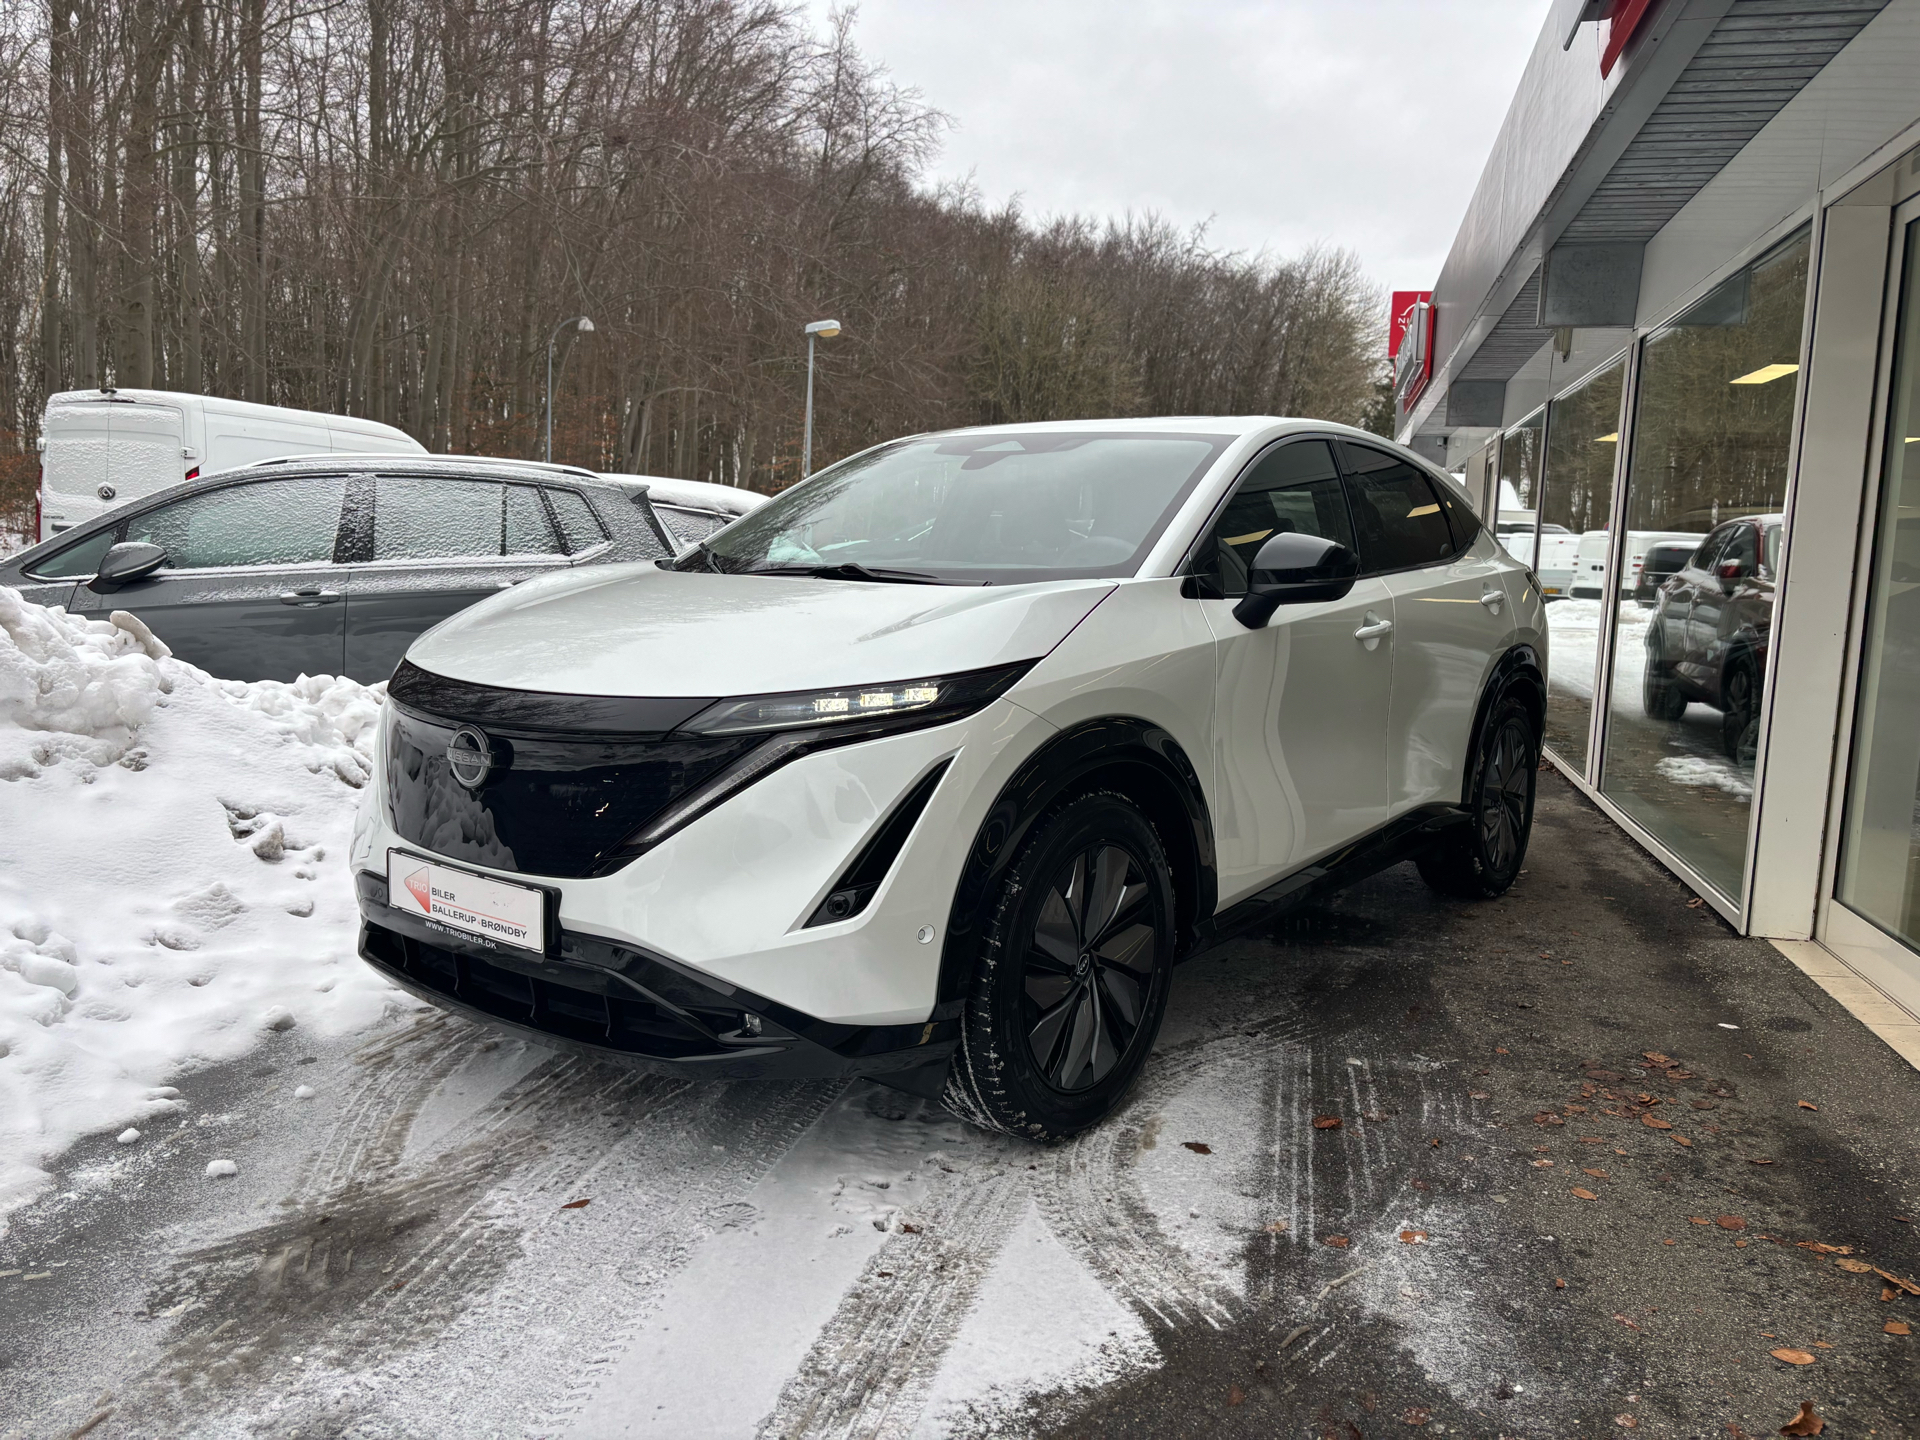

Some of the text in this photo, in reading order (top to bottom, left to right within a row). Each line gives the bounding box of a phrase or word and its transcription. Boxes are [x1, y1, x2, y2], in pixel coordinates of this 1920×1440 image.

[447, 748, 490, 766] NISSAN
[409, 879, 428, 893] TRIO
[431, 886, 456, 902] BILER
[432, 903, 528, 940] BALLERUP BRØNDBY
[425, 920, 497, 950] WWW.TRIOBILER.DK
